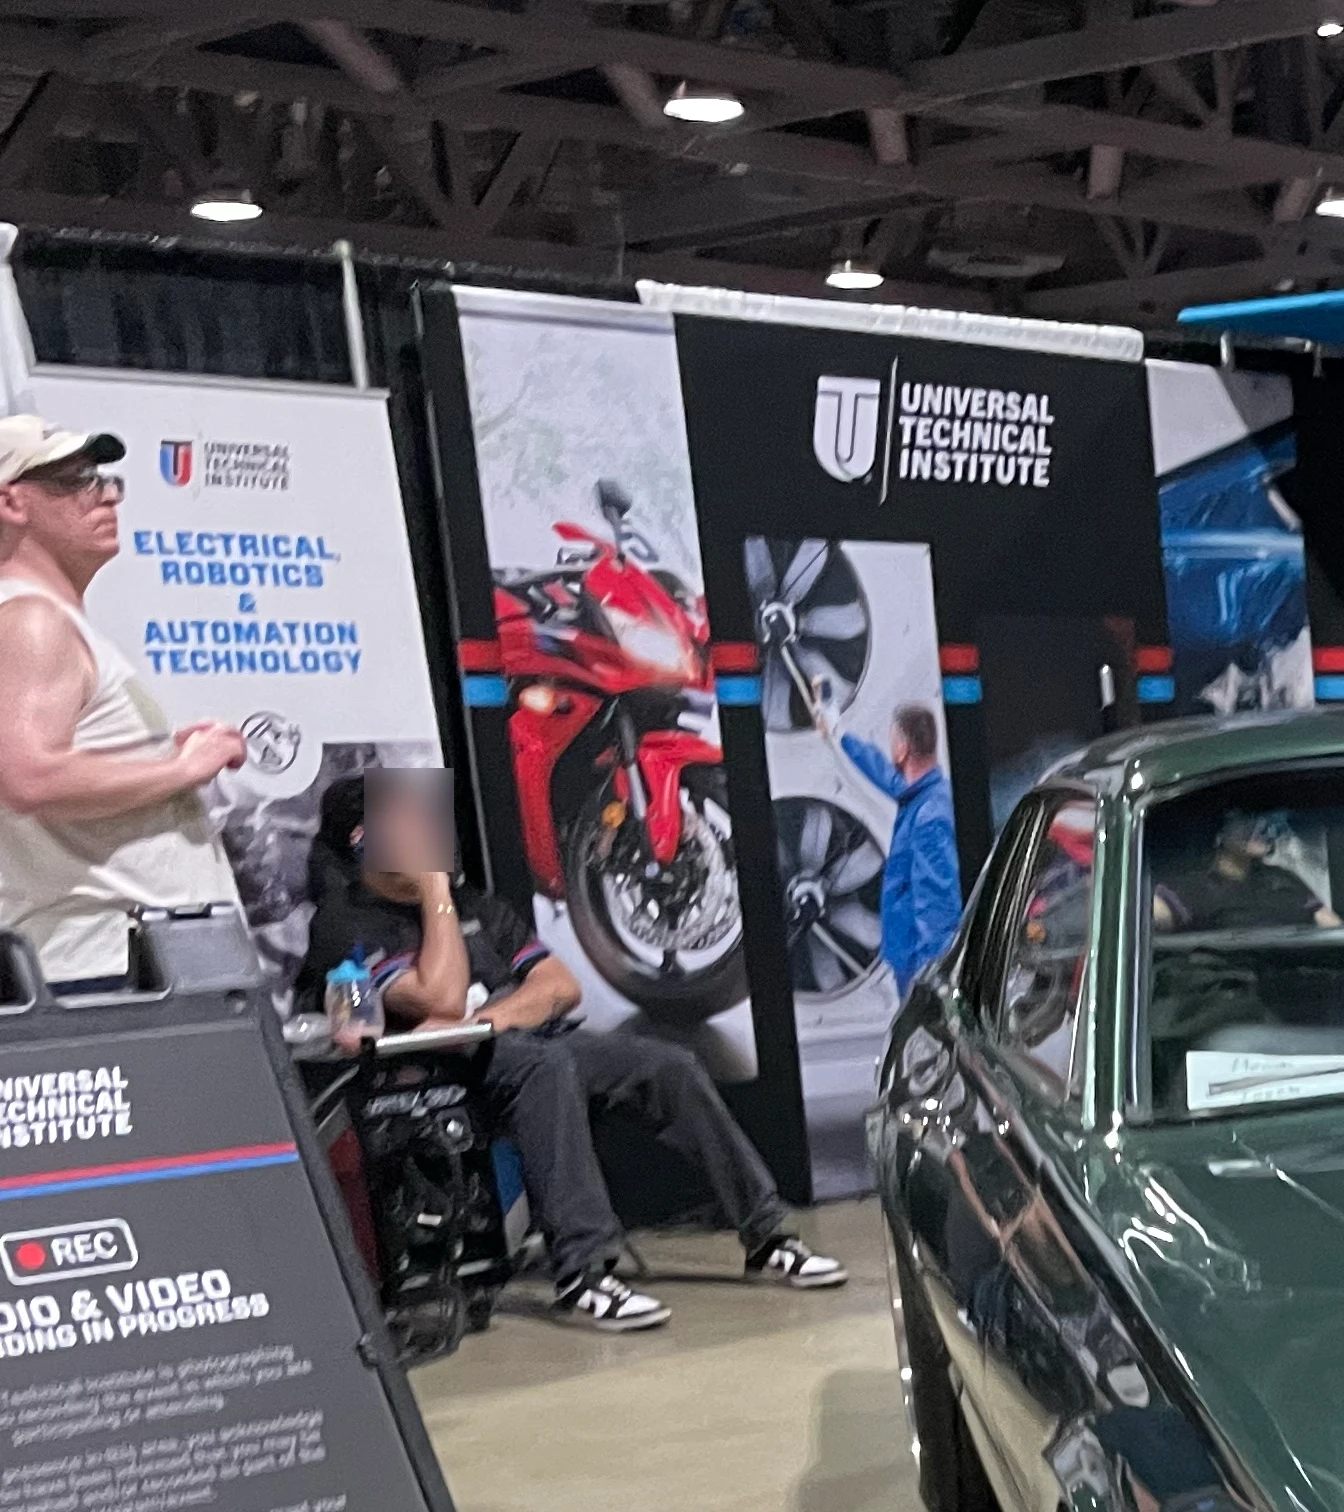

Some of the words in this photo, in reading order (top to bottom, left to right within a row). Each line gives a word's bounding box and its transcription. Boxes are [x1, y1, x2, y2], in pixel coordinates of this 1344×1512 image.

[901, 382, 1055, 425] UNIVERSAL
[899, 415, 1052, 456] TECHNICAL
[900, 448, 1050, 488] INSTITUTE
[161, 560, 324, 588] ROBOTICS
[144, 620, 358, 646] AUTOMATION
[144, 648, 362, 676] TECHNOLOGY
[51, 1231, 118, 1267] REC
[71, 1289, 103, 1322] &
[105, 1269, 231, 1315] VIDEO
[81, 1317, 114, 1345] IN
[117, 1293, 269, 1338] PROGRESS
